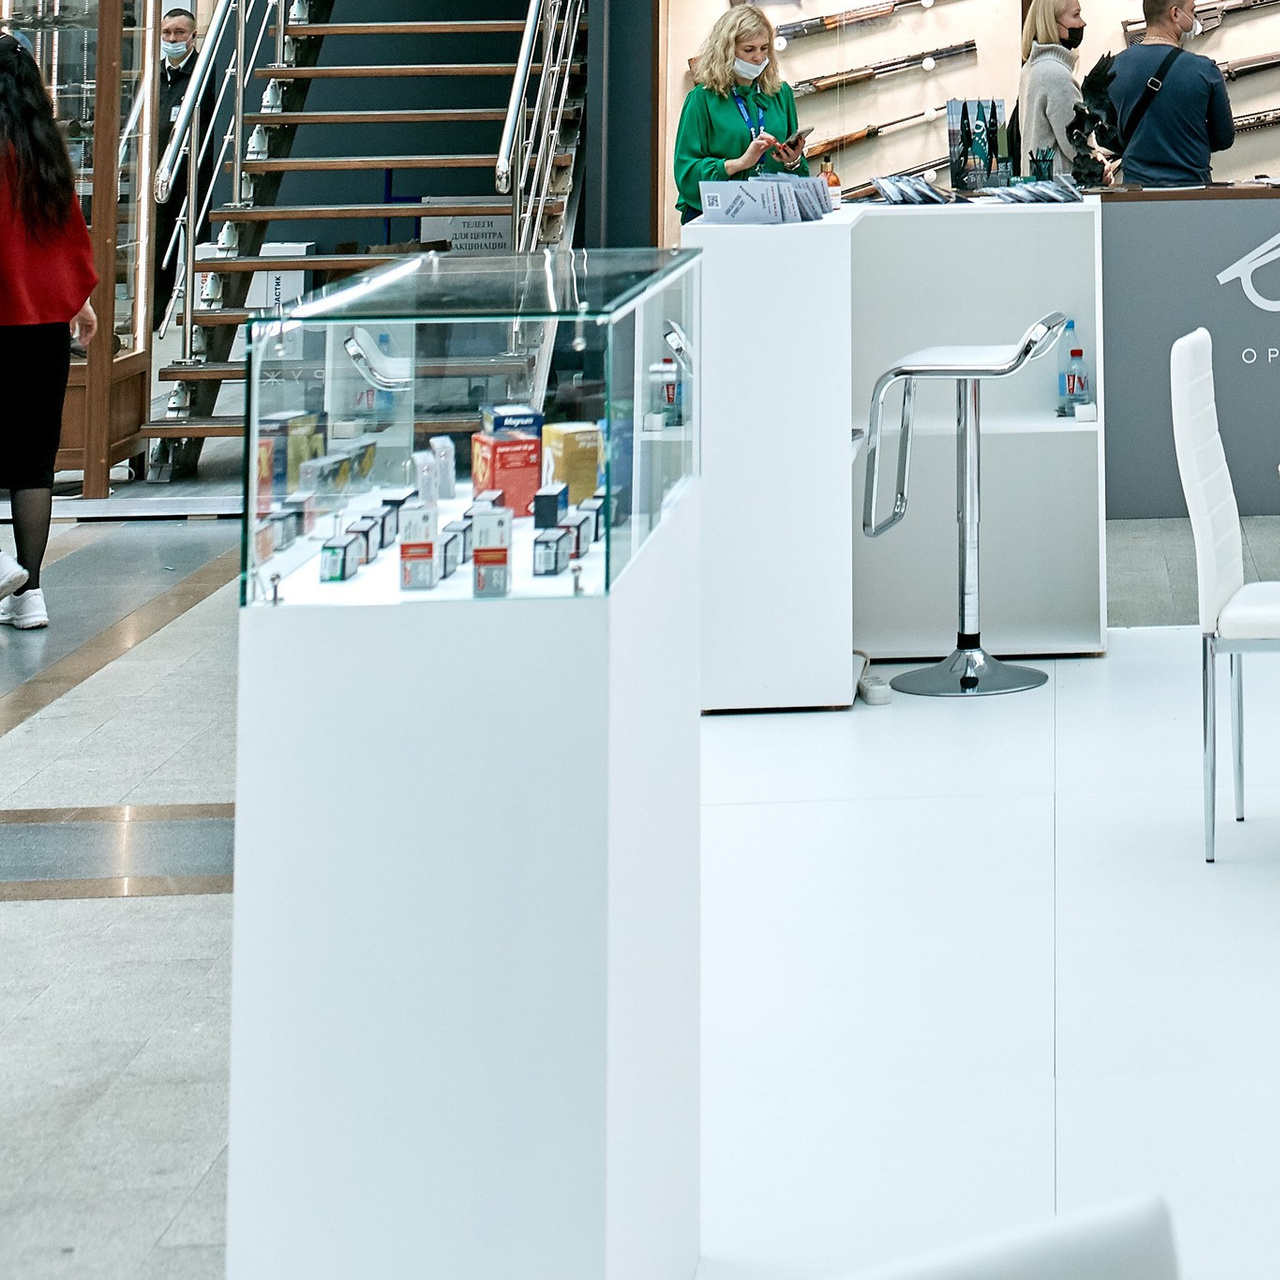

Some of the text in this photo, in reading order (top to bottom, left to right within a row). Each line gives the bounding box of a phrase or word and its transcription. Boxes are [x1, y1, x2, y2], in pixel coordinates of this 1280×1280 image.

[461, 220, 494, 229] ТЕЛЕГИ
[452, 231, 504, 241] ДЛЯ ЦЕНТРА
[503, 416, 534, 427] Magnum
